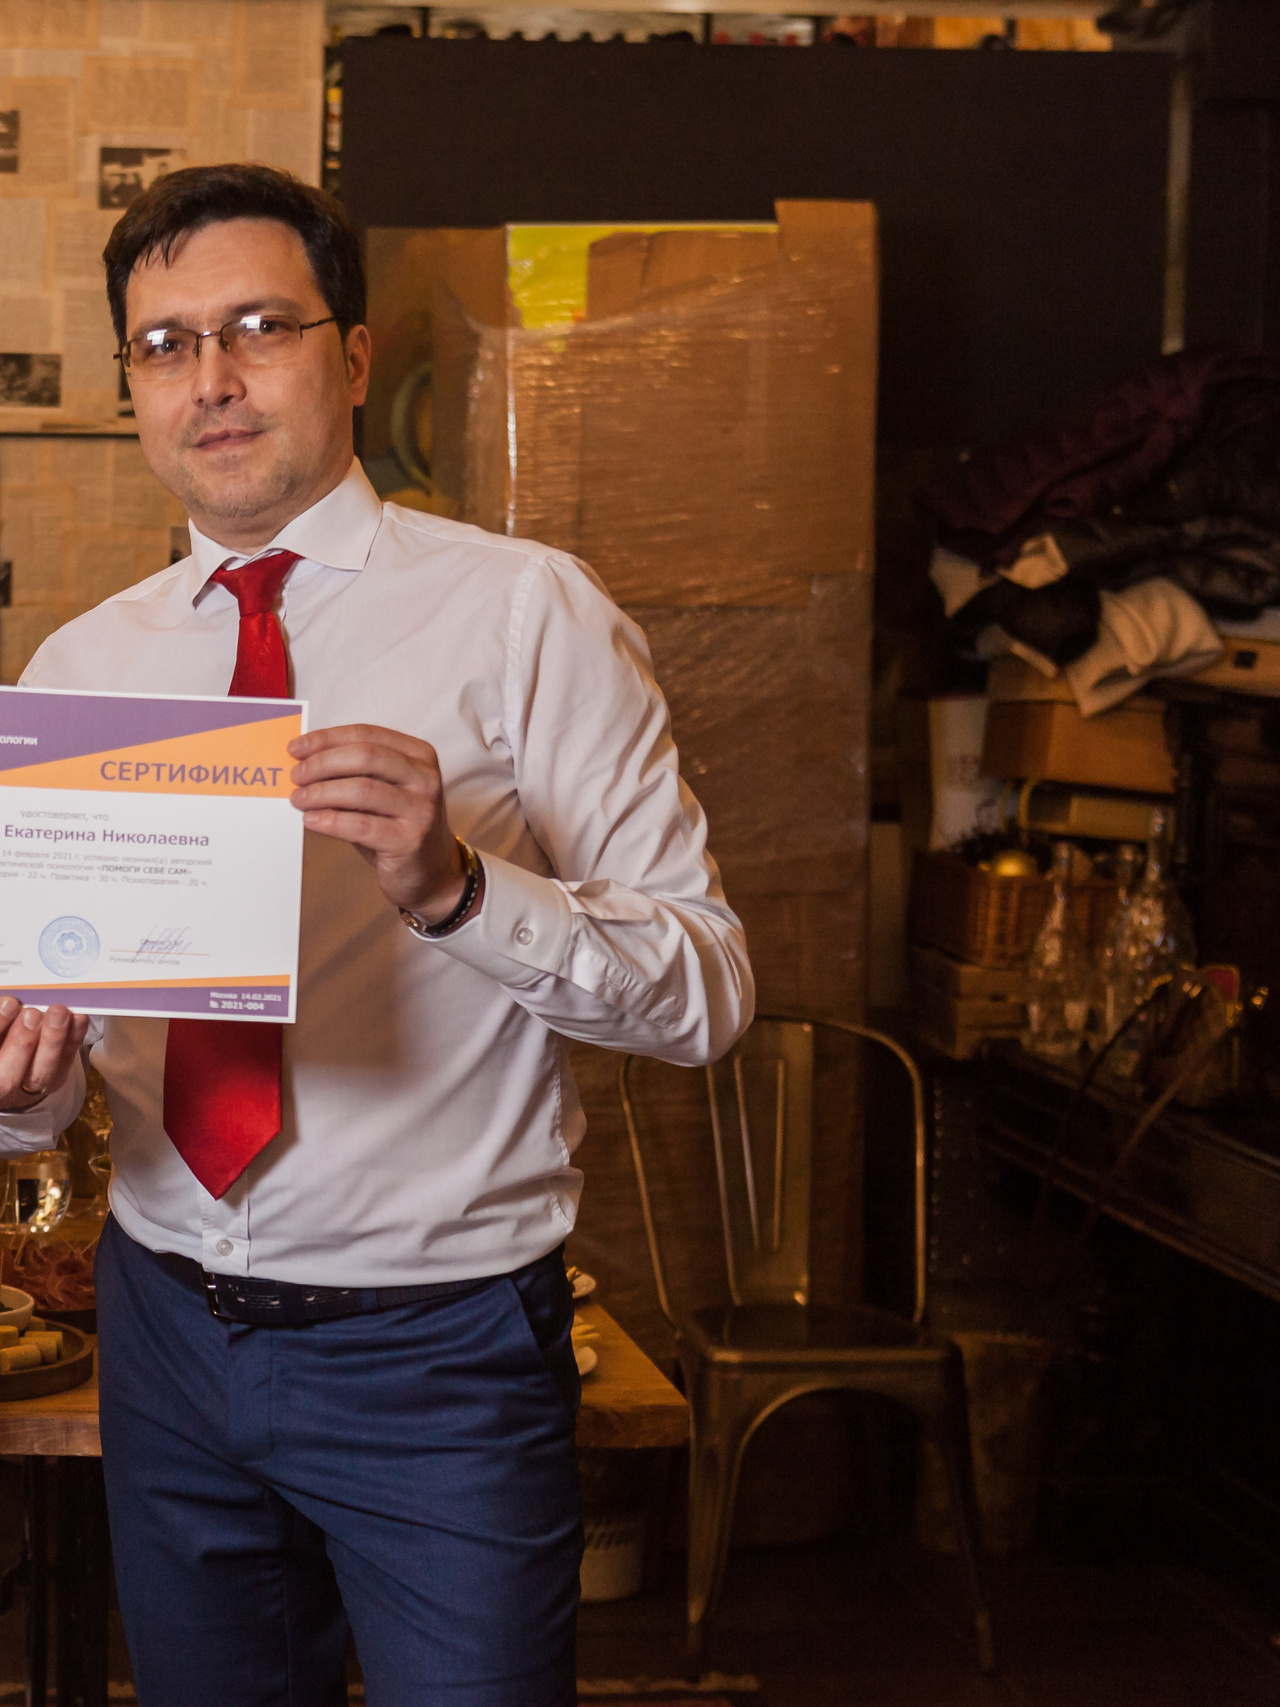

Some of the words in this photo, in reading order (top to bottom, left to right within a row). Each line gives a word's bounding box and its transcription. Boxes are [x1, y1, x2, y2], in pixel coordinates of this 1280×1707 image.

[100, 760, 283, 787] СЕРТИФИКАТ
[20, 809, 89, 822] удостоверяет,
[92, 812, 109, 822] что
[4, 824, 96, 843] Екатерина
[102, 829, 210, 847] Николаевна
[143, 866, 165, 874] СЕБЕ
